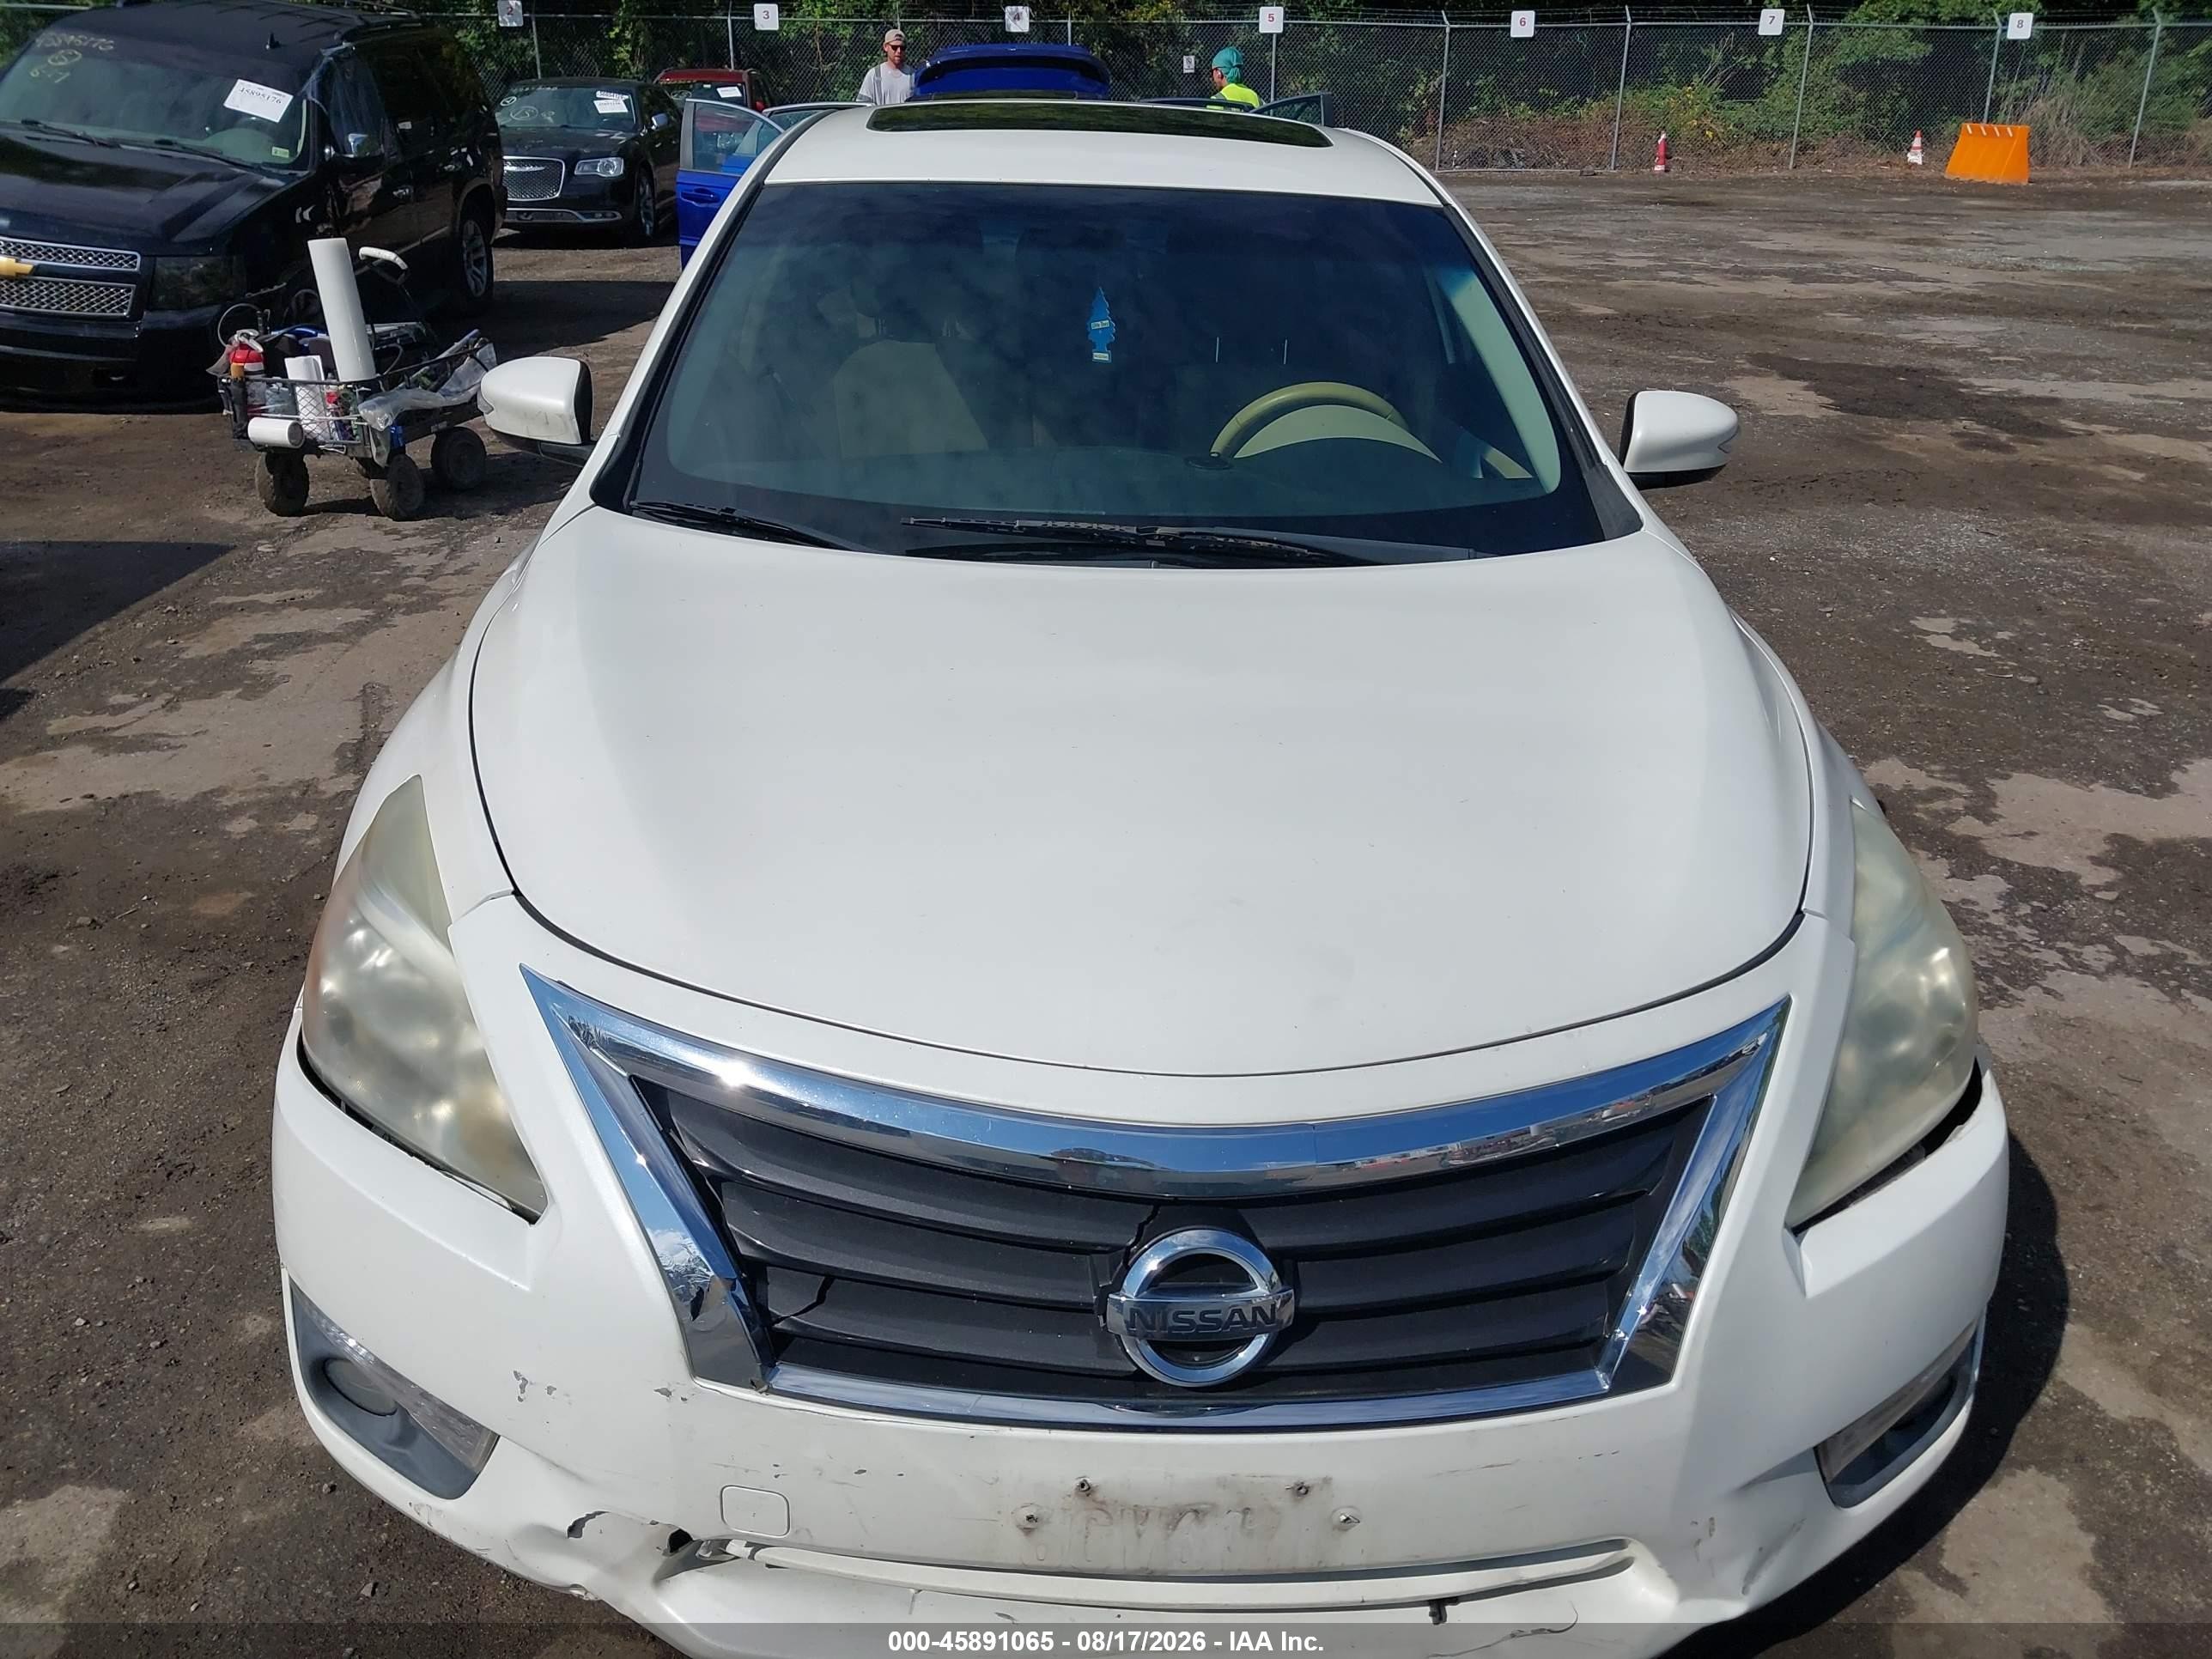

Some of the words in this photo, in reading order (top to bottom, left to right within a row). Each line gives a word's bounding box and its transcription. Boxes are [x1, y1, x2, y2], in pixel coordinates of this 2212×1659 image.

[507, 7, 514, 15] 2
[763, 10, 769, 20] 3
[1014, 12, 1020, 21] 4
[1267, 14, 1274, 22] 5
[1769, 15, 1775, 25] 7
[1520, 17, 1526, 27] 6
[2017, 20, 2023, 28] 8
[1126, 1303, 1276, 1333] NISSAN
